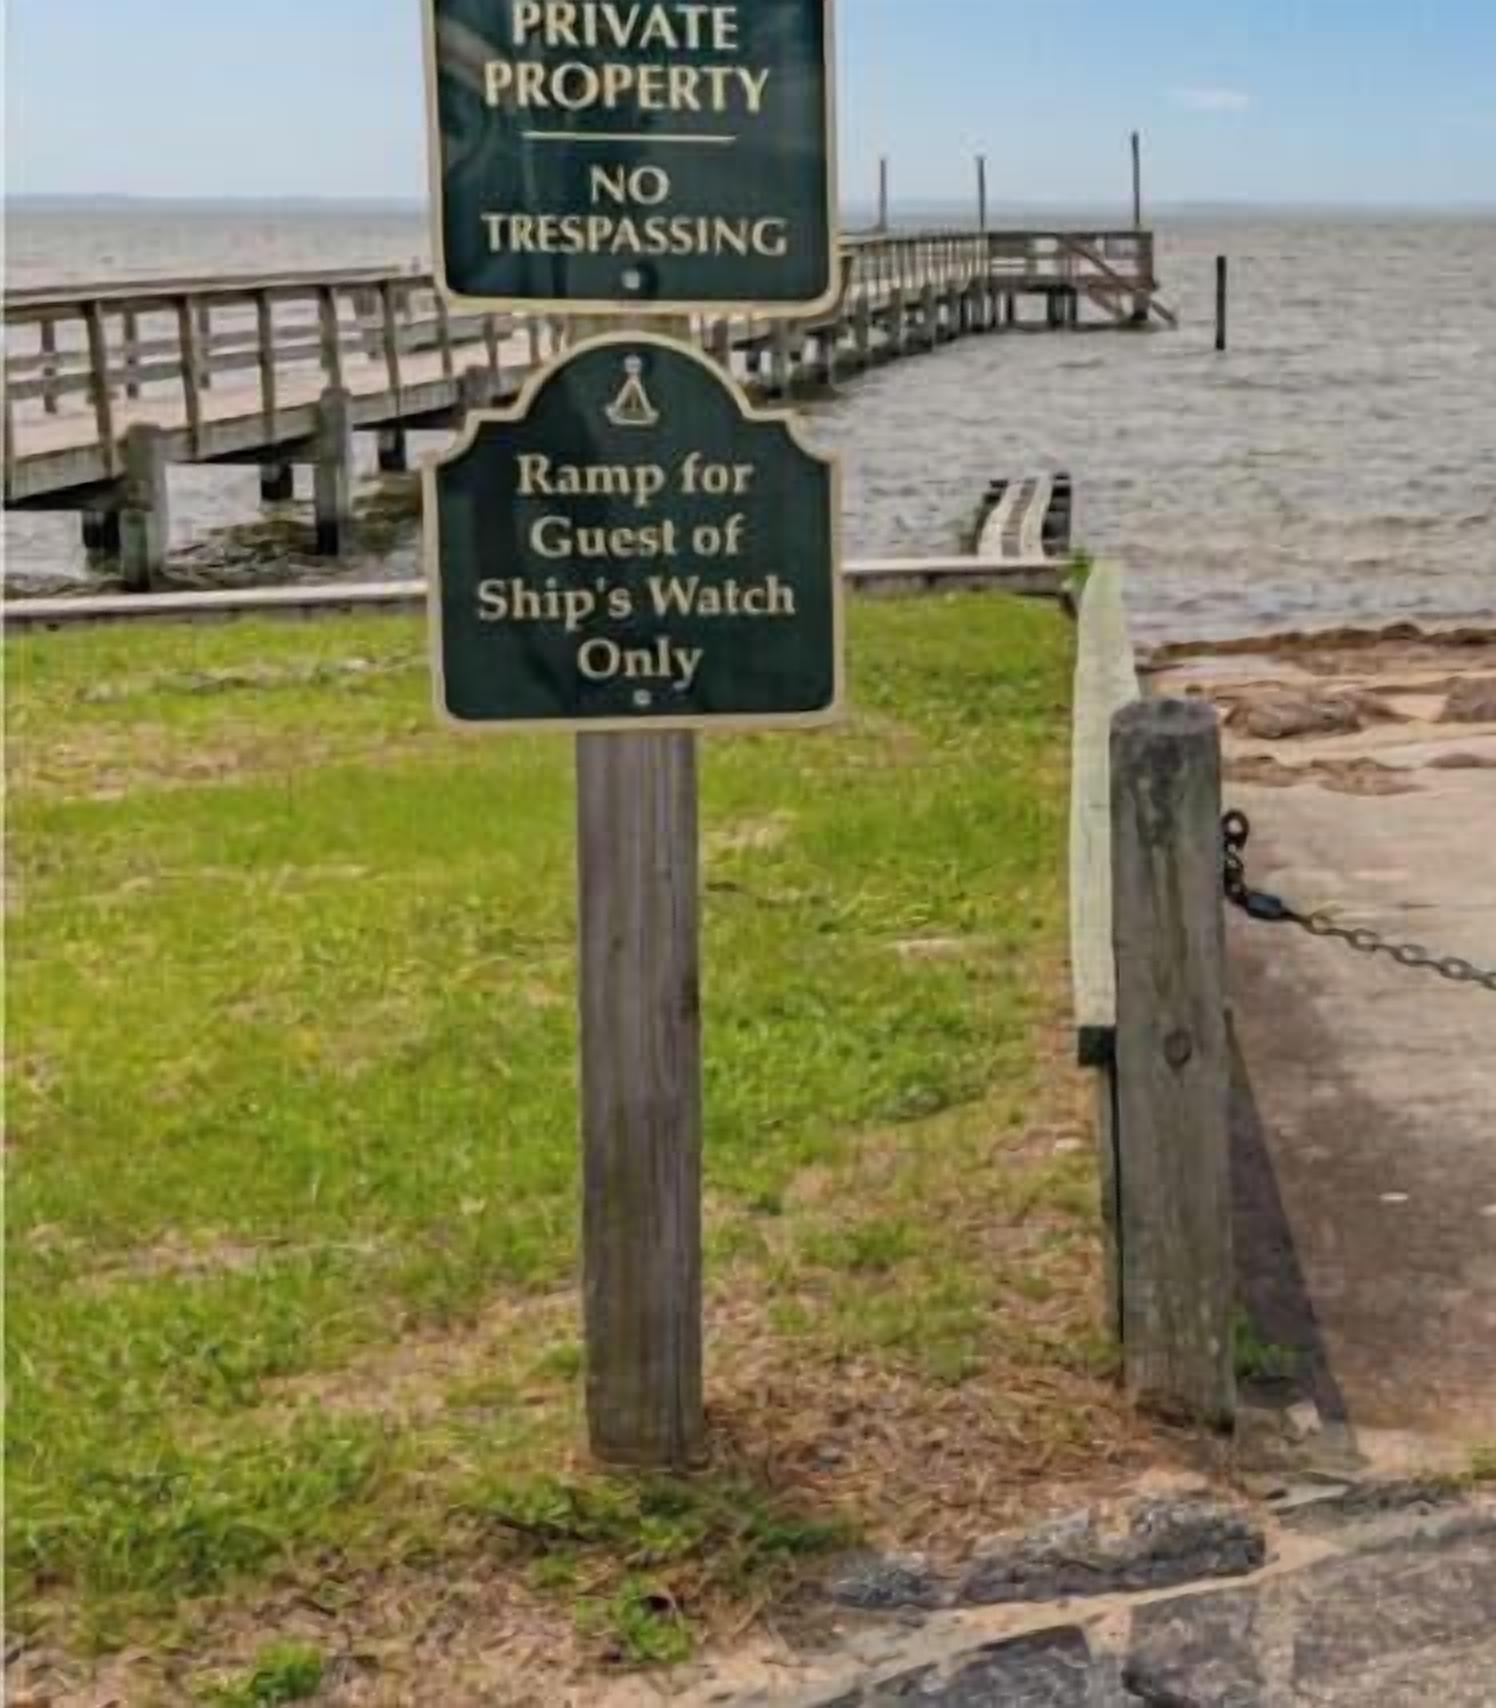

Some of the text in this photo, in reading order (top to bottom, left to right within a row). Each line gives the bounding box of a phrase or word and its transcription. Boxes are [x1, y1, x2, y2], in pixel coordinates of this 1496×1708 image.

[511, 0, 739, 50] PRIVATE
[483, 60, 770, 113] PROPERTY
[590, 165, 671, 205] NO
[482, 213, 788, 257] TRESPASSING
[516, 451, 755, 509] Ramp for
[529, 512, 747, 559] Guest of
[476, 574, 797, 631] Ship's Watch
[576, 636, 704, 690] Only
